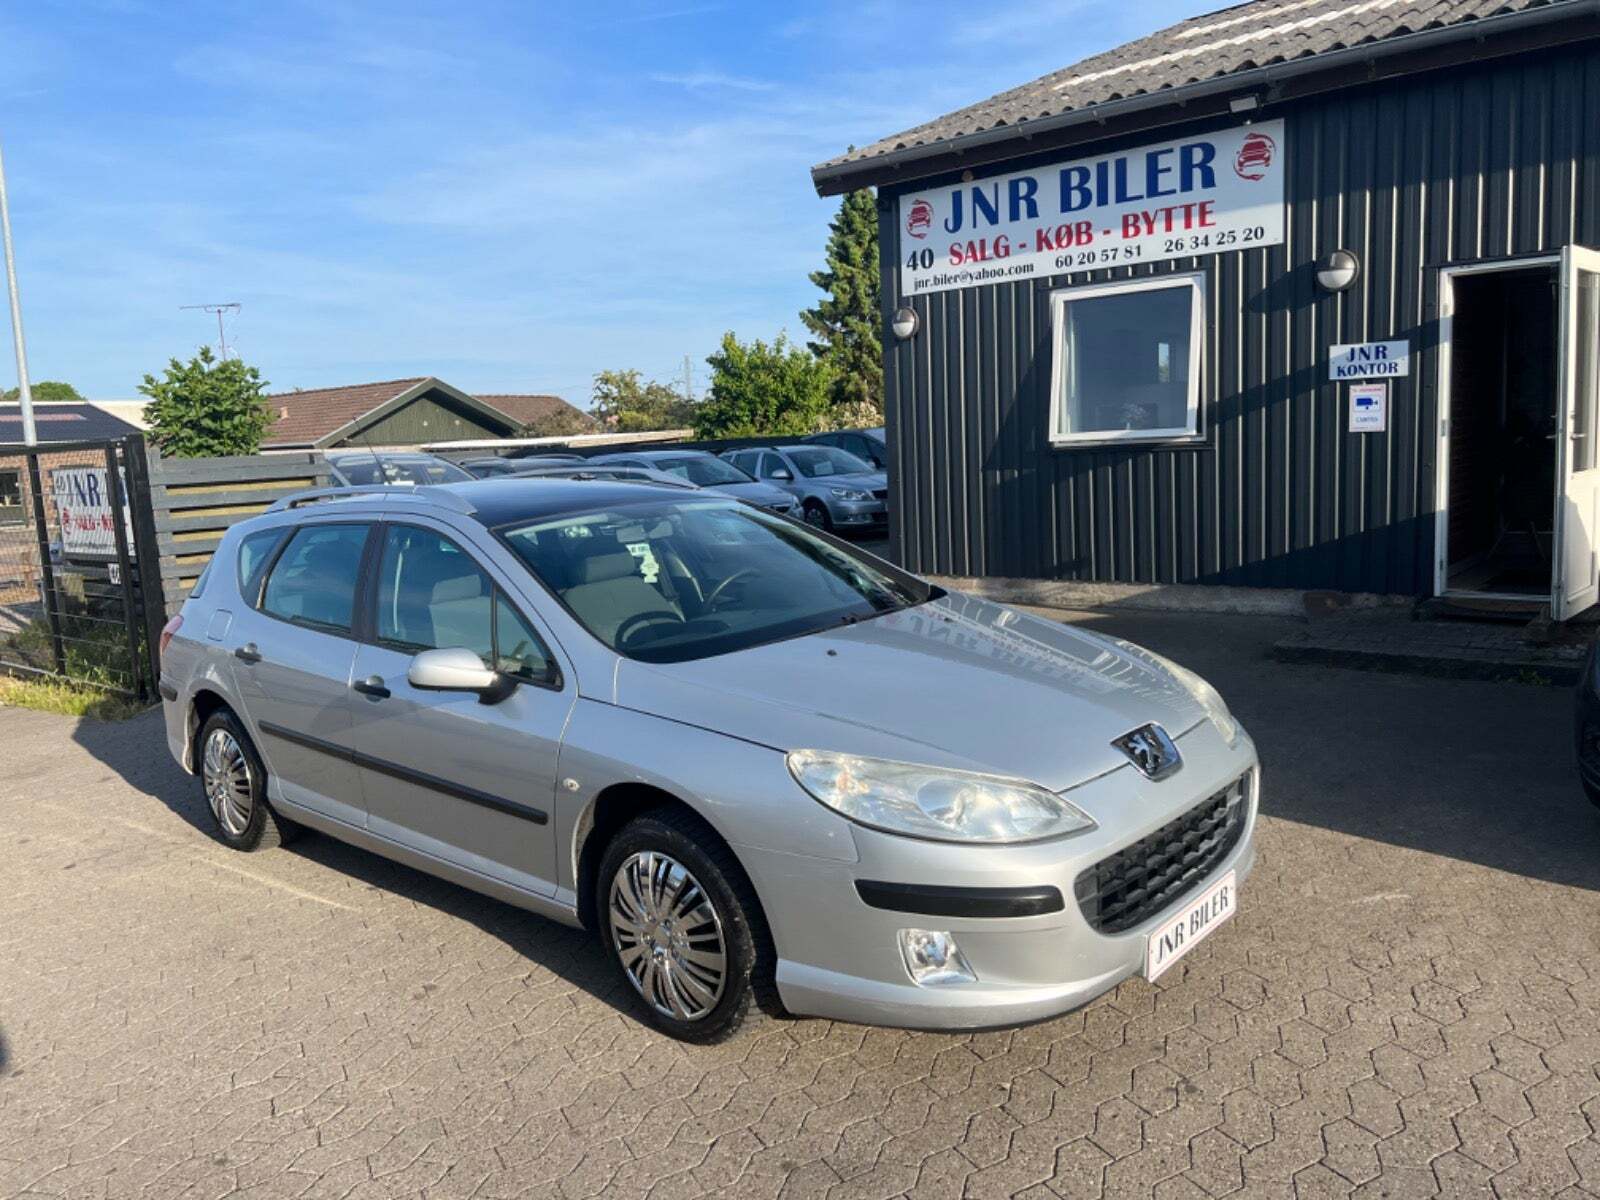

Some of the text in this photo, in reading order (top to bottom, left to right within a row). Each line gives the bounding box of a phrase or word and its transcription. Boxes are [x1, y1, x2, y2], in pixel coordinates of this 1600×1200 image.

[944, 142, 1216, 234] JNR BILER
[950, 234, 1010, 266] SALG
[1036, 220, 1093, 252] KØB
[1122, 200, 1216, 239] BYTTE
[1055, 226, 1265, 268] 60 20 57 81 26 34 25 20
[906, 248, 934, 271] 40
[914, 262, 1034, 291] jnr.biler@yahoo.com
[1336, 362, 1398, 377] KONTOR
[1346, 345, 1388, 362] JNR
[1156, 886, 1228, 964] JNR BILER
